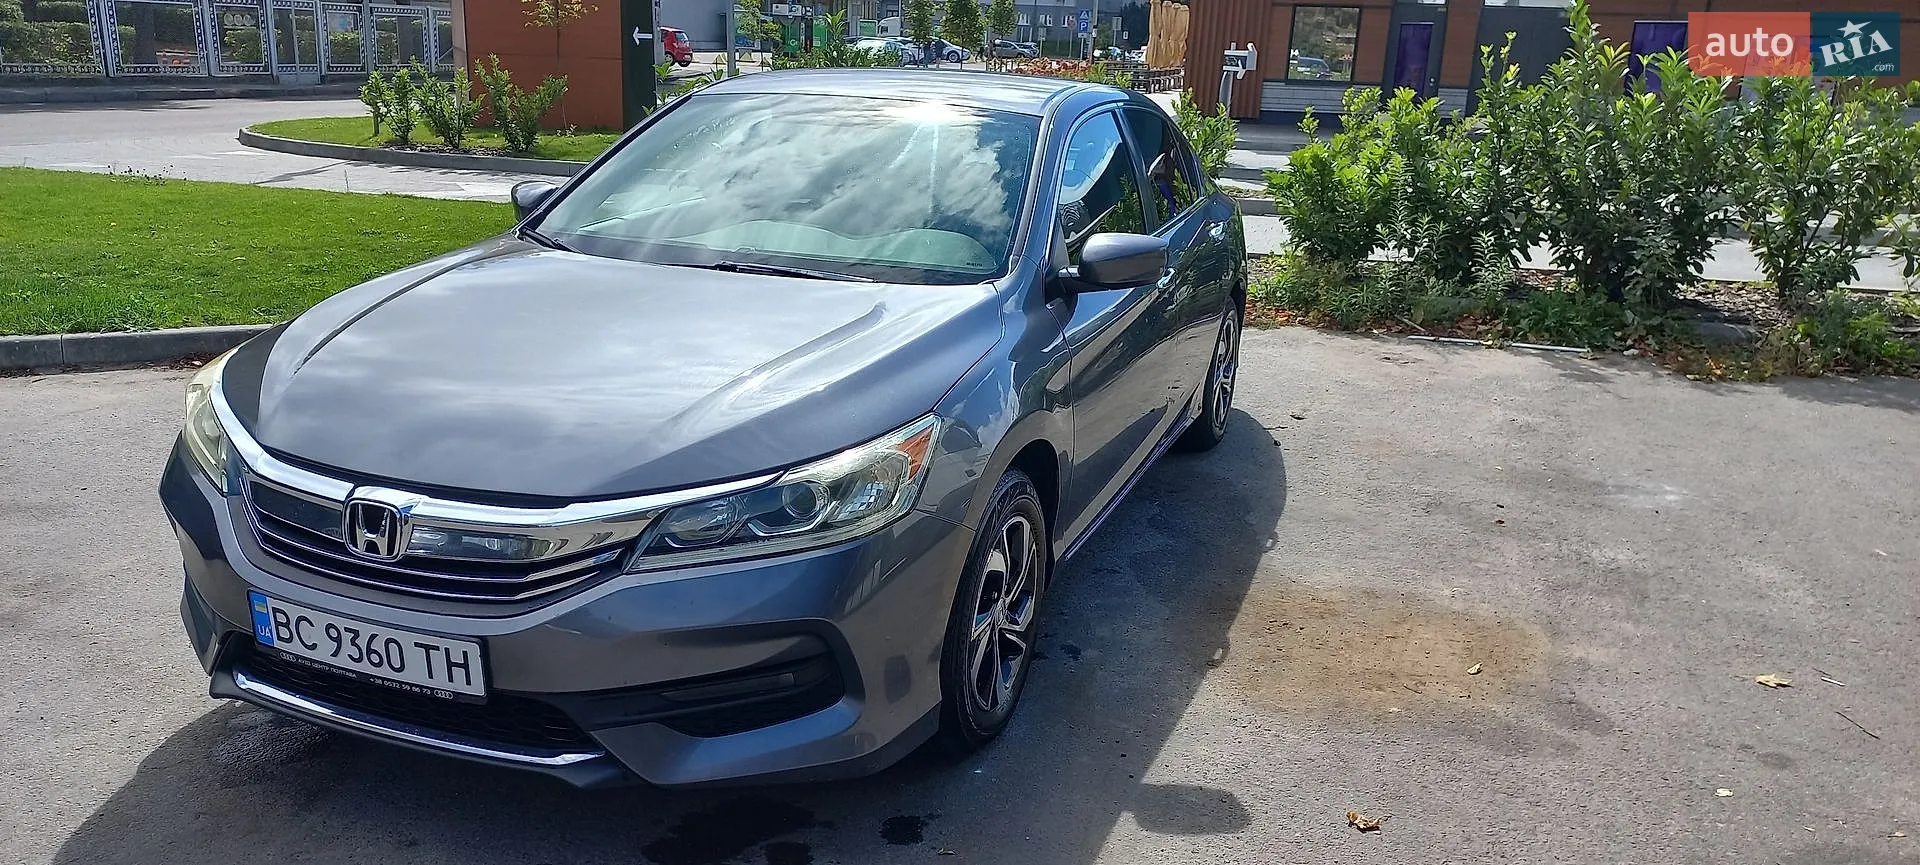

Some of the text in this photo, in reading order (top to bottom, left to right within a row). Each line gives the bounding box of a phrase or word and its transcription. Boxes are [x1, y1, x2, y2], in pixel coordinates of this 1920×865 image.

[258, 624, 272, 638] UA
[271, 606, 472, 686] BC 9360 TH
